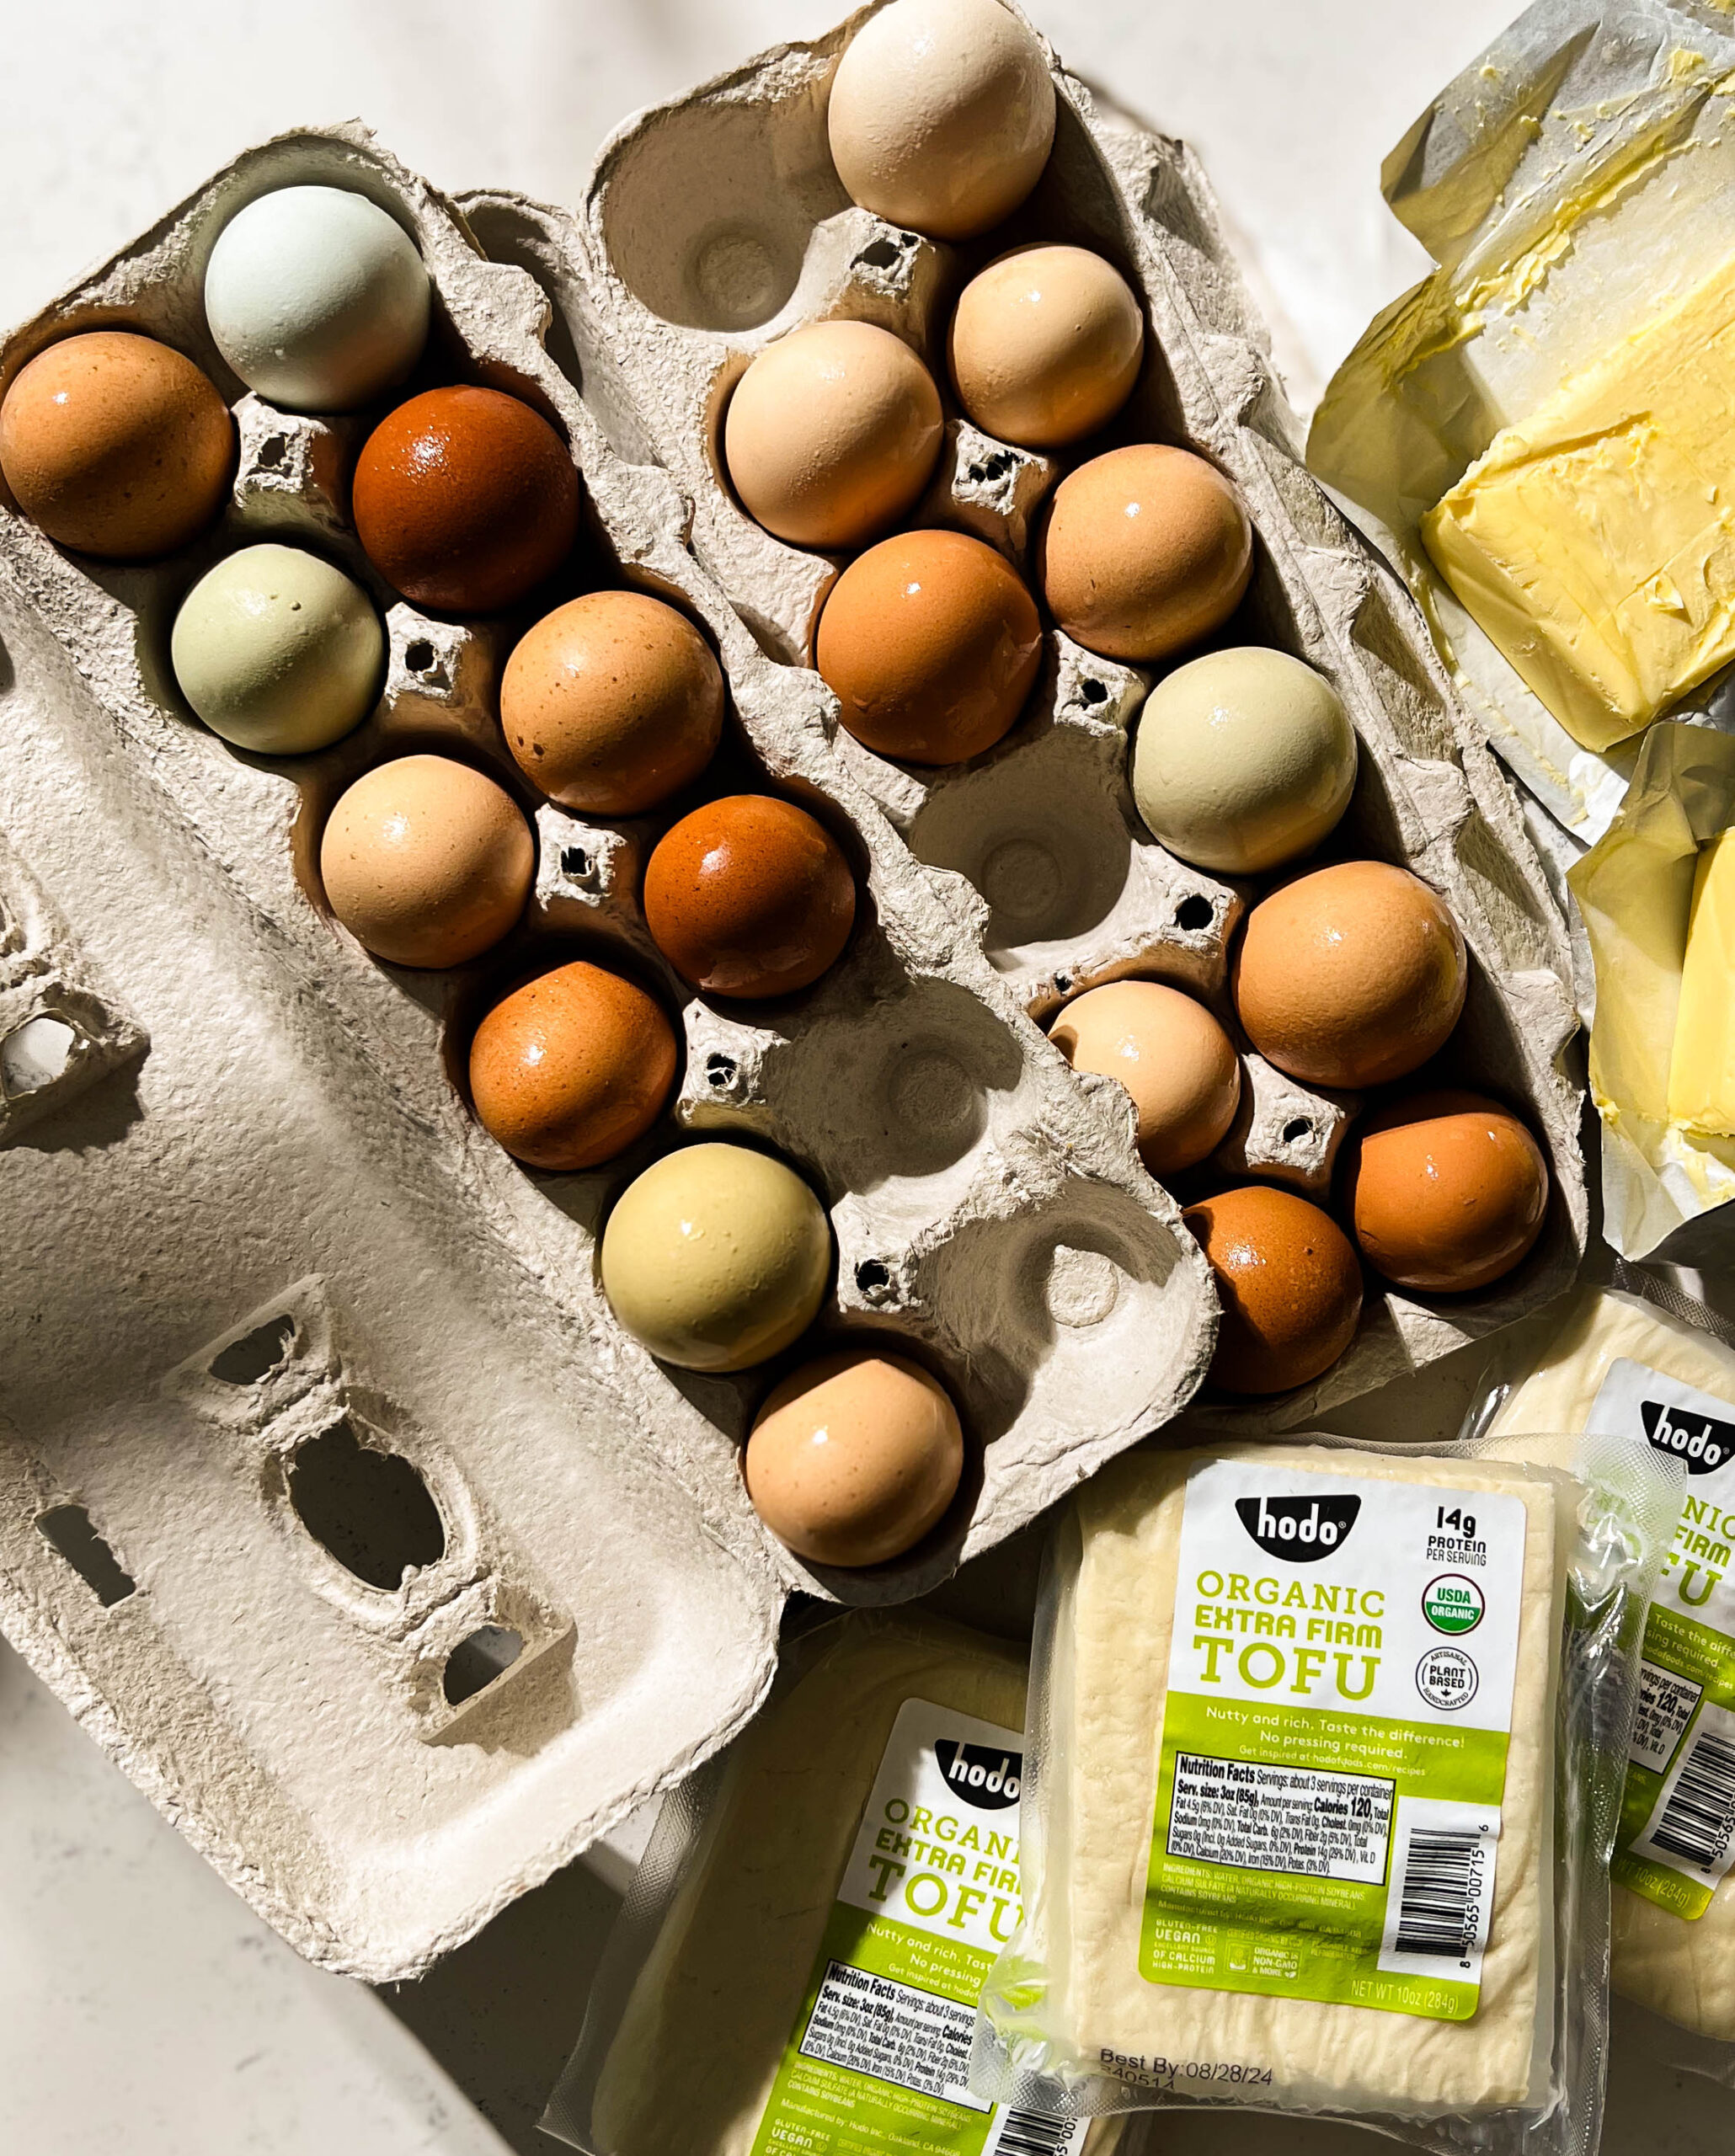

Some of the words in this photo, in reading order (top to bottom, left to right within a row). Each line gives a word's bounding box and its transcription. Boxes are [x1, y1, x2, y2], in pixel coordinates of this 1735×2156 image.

[1652, 1406, 1722, 1465] hodo
[1257, 1497, 1340, 1546] hodo
[1435, 1506, 1476, 1539] 14g
[1426, 1547, 1444, 1561] PER
[1446, 1550, 1487, 1566] SERVING
[1428, 1535, 1487, 1553] PROTEIN
[1195, 1568, 1385, 1619] ORGANIC
[1436, 1587, 1471, 1604] USDA
[1194, 1603, 1296, 1638] EXTRA
[1306, 1617, 1383, 1649] FIRM
[1431, 1604, 1475, 1620] ORGANIC
[1655, 1613, 1685, 1636] Taste
[1688, 1630, 1707, 1646] the
[1189, 1634, 1381, 1703] TOFU
[1431, 1652, 1467, 1666] ARTISANAL
[1671, 1639, 1721, 1670] required.
[1428, 1676, 1465, 1689] BASED
[1429, 1665, 1465, 1678] PLANT
[1423, 1687, 1469, 1706] HANDCRAFTED
[1657, 1691, 1678, 1716] 120,
[1670, 1681, 1700, 1703] container
[1206, 1705, 1249, 1725] Nutty
[1252, 1711, 1279, 1726] and
[1284, 1715, 1315, 1730] rich.
[1319, 1719, 1357, 1735] Taste
[1361, 1725, 1385, 1738] the
[1389, 1727, 1465, 1748] difference!
[1239, 1744, 1257, 1755] Get
[1258, 1747, 1297, 1762] inspired
[1299, 1753, 1311, 1761] at
[1260, 1730, 1280, 1742] No
[1283, 1732, 1341, 1753] pressing
[1344, 1739, 1408, 1761] required.
[948, 1742, 1021, 1799] hodo
[1179, 1755, 1225, 1778] Nutrition
[1226, 1763, 1256, 1784] Facts
[1256, 1769, 1289, 1791] Servings:
[1289, 1773, 1310, 1790] about
[1310, 1775, 1316, 1790] 3
[1316, 1775, 1347, 1798] servings
[1346, 1783, 1359, 1798] per
[1359, 1781, 1393, 1801] container
[1177, 1778, 1199, 1796] Serv.
[1200, 1781, 1220, 1799] size:
[1220, 1785, 1235, 1801] 3oz
[1236, 1787, 1260, 1807] (85g),
[1260, 1793, 1282, 1807] Amount
[1282, 1797, 1291, 1812] per
[1313, 1796, 1348, 1816] Calories
[1349, 1796, 1374, 1821] 120,
[1373, 1806, 1389, 1820] Total
[1173, 1810, 1197, 1826] Sodium
[1197, 1815, 1210, 1831] 0mg
[1236, 1820, 1252, 1833] Total
[1252, 1822, 1269, 1836] Carb.
[1270, 1825, 1279, 1840] 6g
[1304, 1828, 1319, 1842] Fiber
[1319, 1830, 1327, 1845] 2g
[1353, 1834, 1368, 1848] Total
[1176, 1796, 1186, 1809] Fat
[1186, 1798, 1199, 1814] 4.5g
[1239, 1805, 1248, 1817] Fat
[1248, 1806, 1257, 1822] 0g
[1285, 1812, 1300, 1825] Trans
[1300, 1813, 1311, 1826] Fat
[1347, 1818, 1362, 1836] 0mg
[875, 1828, 966, 1875] EXTRA
[1172, 1826, 1192, 1842] Sugars
[1193, 1830, 1201, 1844] 0g
[1216, 1833, 1225, 1848] 0g
[1225, 1835, 1245, 1848] Added
[1268, 1839, 1279, 1852] 0%
[1294, 1843, 1316, 1855] Protein
[1316, 1845, 1327, 1860] 14g
[1369, 1851, 1375, 1864] D
[1467, 1849, 1485, 1897] 00715
[868, 1854, 1027, 1942] TOFU
[1657, 1877, 1690, 1909] (284g)
[1155, 1927, 1200, 1945] VEGAN
[1156, 1918, 1218, 1933] GLUTEN-FREE
[1461, 1903, 1480, 1947] 50565
[865, 1922, 905, 1945] Nutty
[905, 1935, 932, 1952] and
[932, 1944, 964, 1963] rich.
[964, 1954, 993, 1972] Tast
[1153, 1949, 1166, 1959] OF
[1168, 1951, 1215, 1966] CALCIUM
[1254, 1946, 1289, 1959] ORGANIC
[887, 1961, 905, 1975] Get
[905, 1967, 941, 1988] inspired
[941, 1980, 952, 1990] at
[909, 1952, 929, 1968] No
[928, 1960, 982, 1988] pressing
[1152, 1959, 1214, 1975] HIGH-PROTEIN
[1252, 1956, 1297, 1970] NON-GMO
[1259, 1967, 1282, 1977] MORE
[1459, 1960, 1471, 1968] 8
[827, 1963, 872, 1991] Nutrition
[868, 1977, 897, 2000] Facts
[894, 1988, 926, 2014] Servings:
[924, 1999, 945, 2017] about
[942, 2004, 950, 2019] 3
[947, 2007, 977, 2030] servings
[1351, 1979, 1373, 1998] NET
[1375, 1983, 1394, 2001] WT
[1396, 1986, 1421, 2005] 10oz
[1423, 1990, 1459, 2014] (284g)
[821, 1984, 843, 2003] Serv.
[841, 1990, 862, 2009] size:
[858, 1997, 875, 2014] 3oz
[941, 2024, 974, 2046] Calories
[1100, 2048, 1146, 2071] Best
[771, 2127, 813, 2148] VEGAN
[775, 2118, 831, 2142] GLUTEN-FREE
